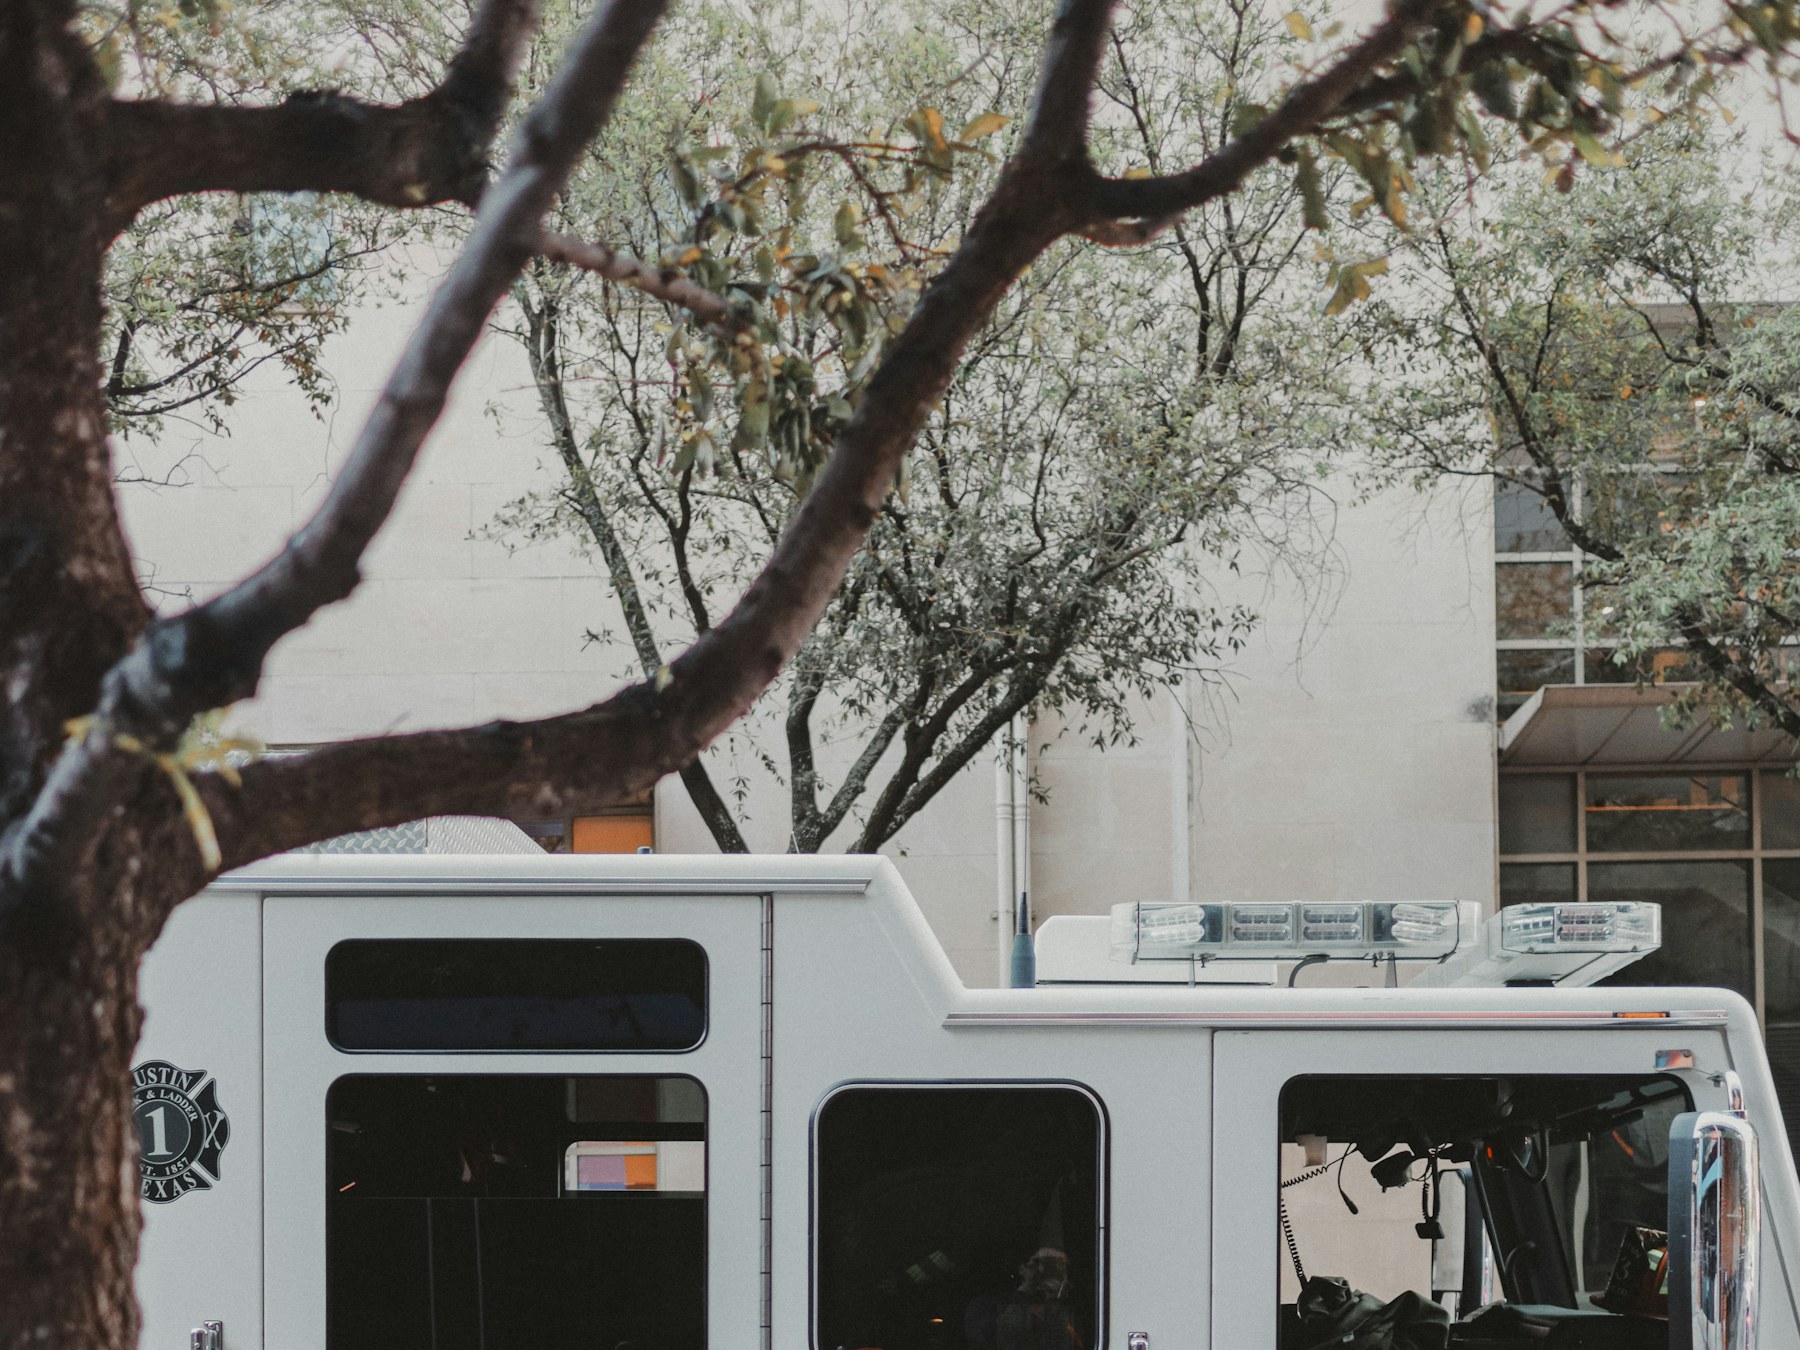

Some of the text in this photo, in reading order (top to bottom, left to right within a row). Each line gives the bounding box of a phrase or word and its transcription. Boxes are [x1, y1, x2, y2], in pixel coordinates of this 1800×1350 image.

[132, 1067, 193, 1091] USTIN
[146, 1089, 156, 1099] &
[160, 1089, 198, 1122] LADDER
[145, 1106, 173, 1156] 1
[165, 1156, 189, 1176] 1857
[140, 1171, 197, 1198] EXAS
